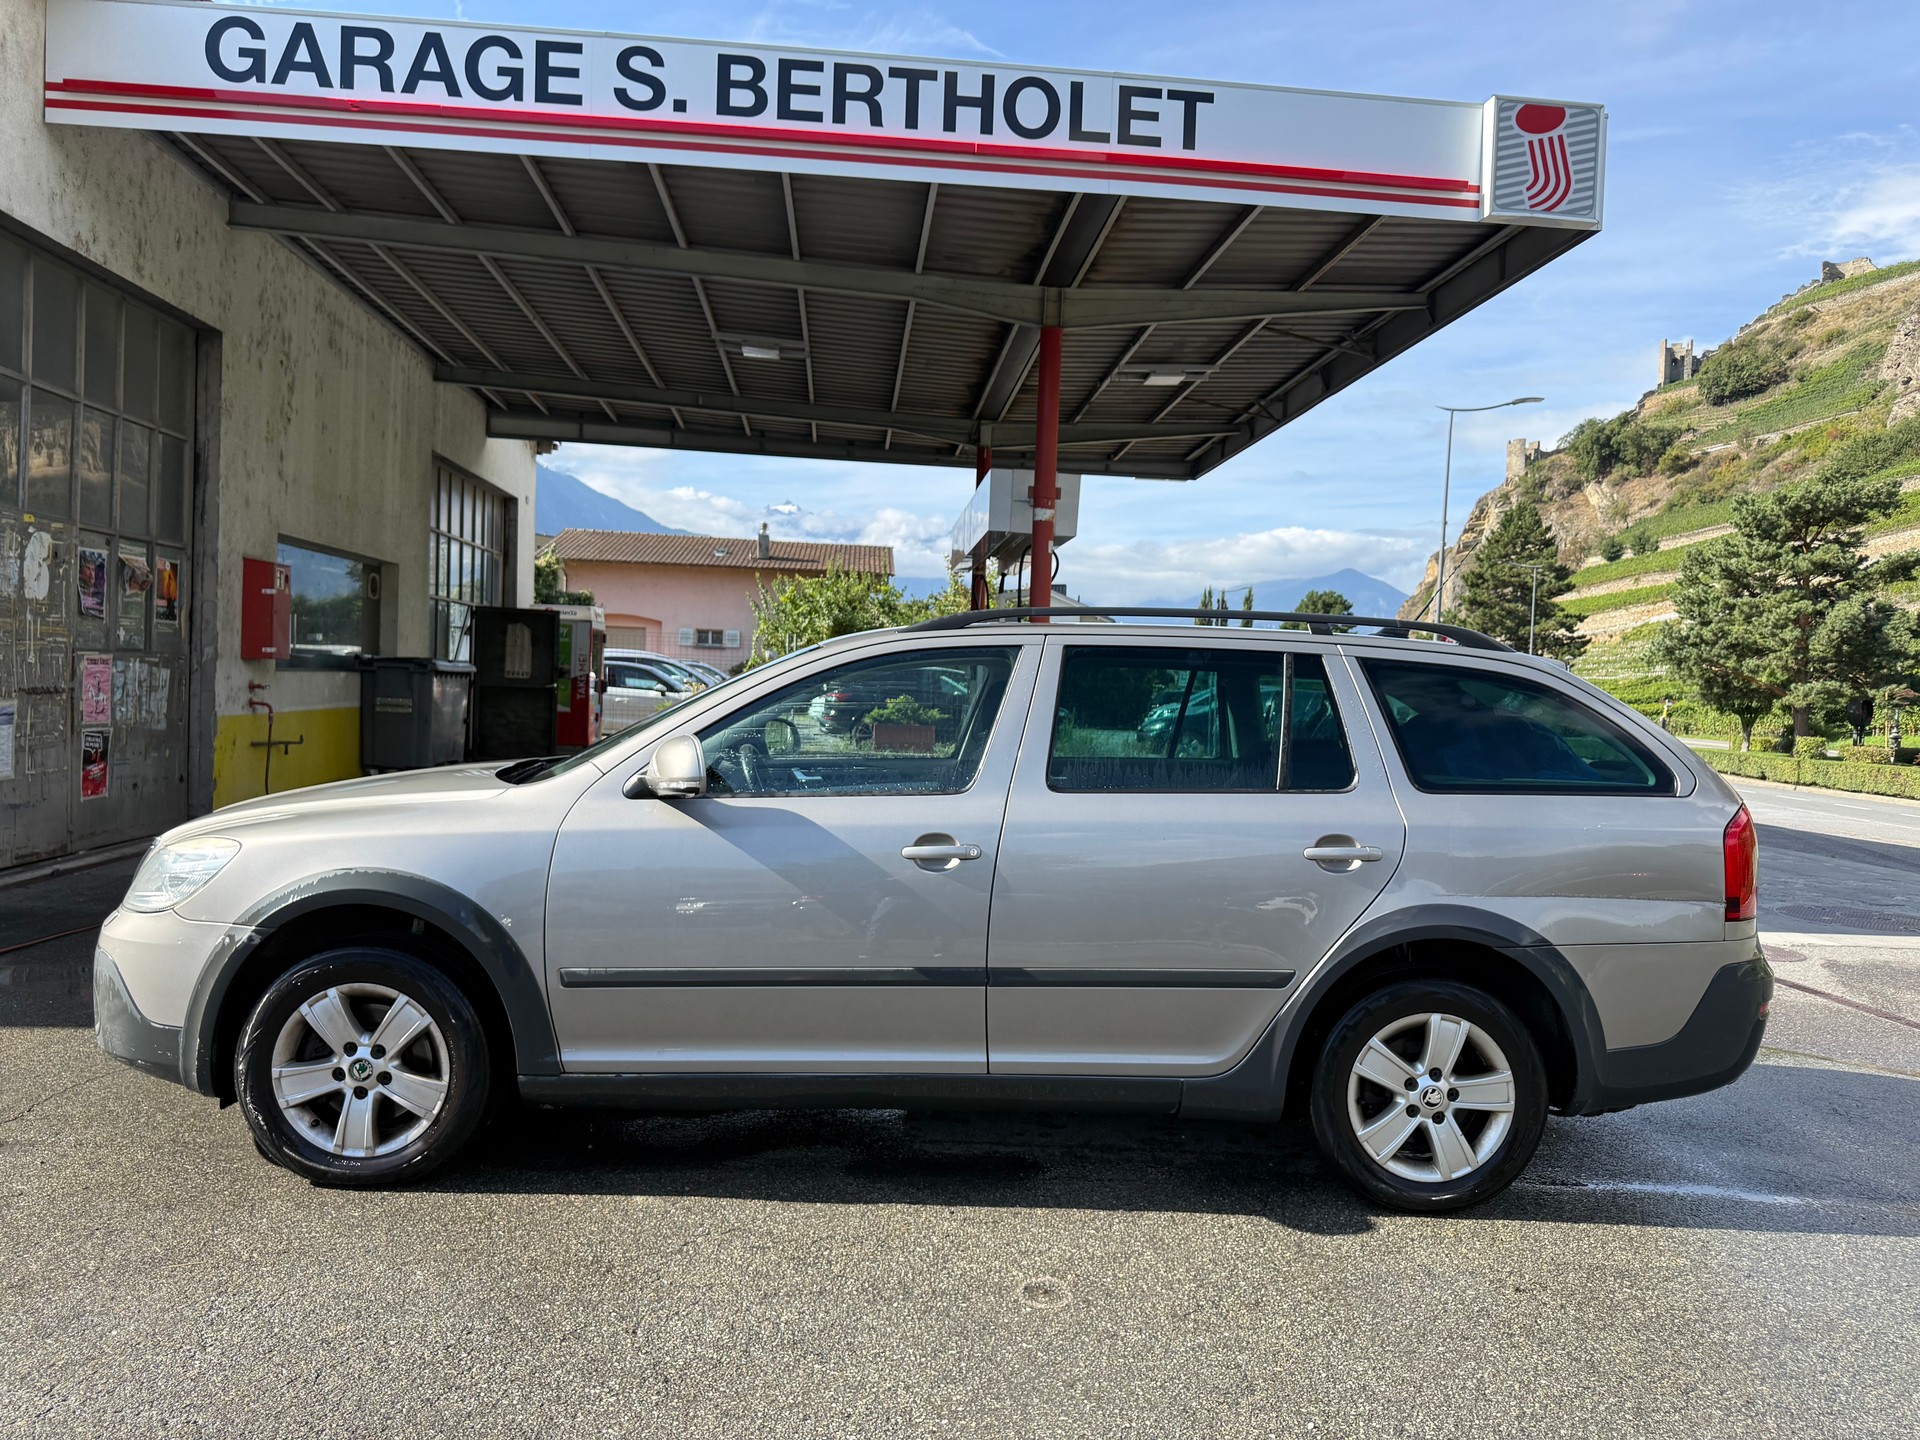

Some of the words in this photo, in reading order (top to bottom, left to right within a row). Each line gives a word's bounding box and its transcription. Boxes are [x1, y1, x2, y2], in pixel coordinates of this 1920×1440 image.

[204, 15, 583, 106] GARAGE
[613, 46, 687, 112] S.
[716, 53, 1214, 150] BERTHOLET
[576, 675, 587, 700] TAKE
